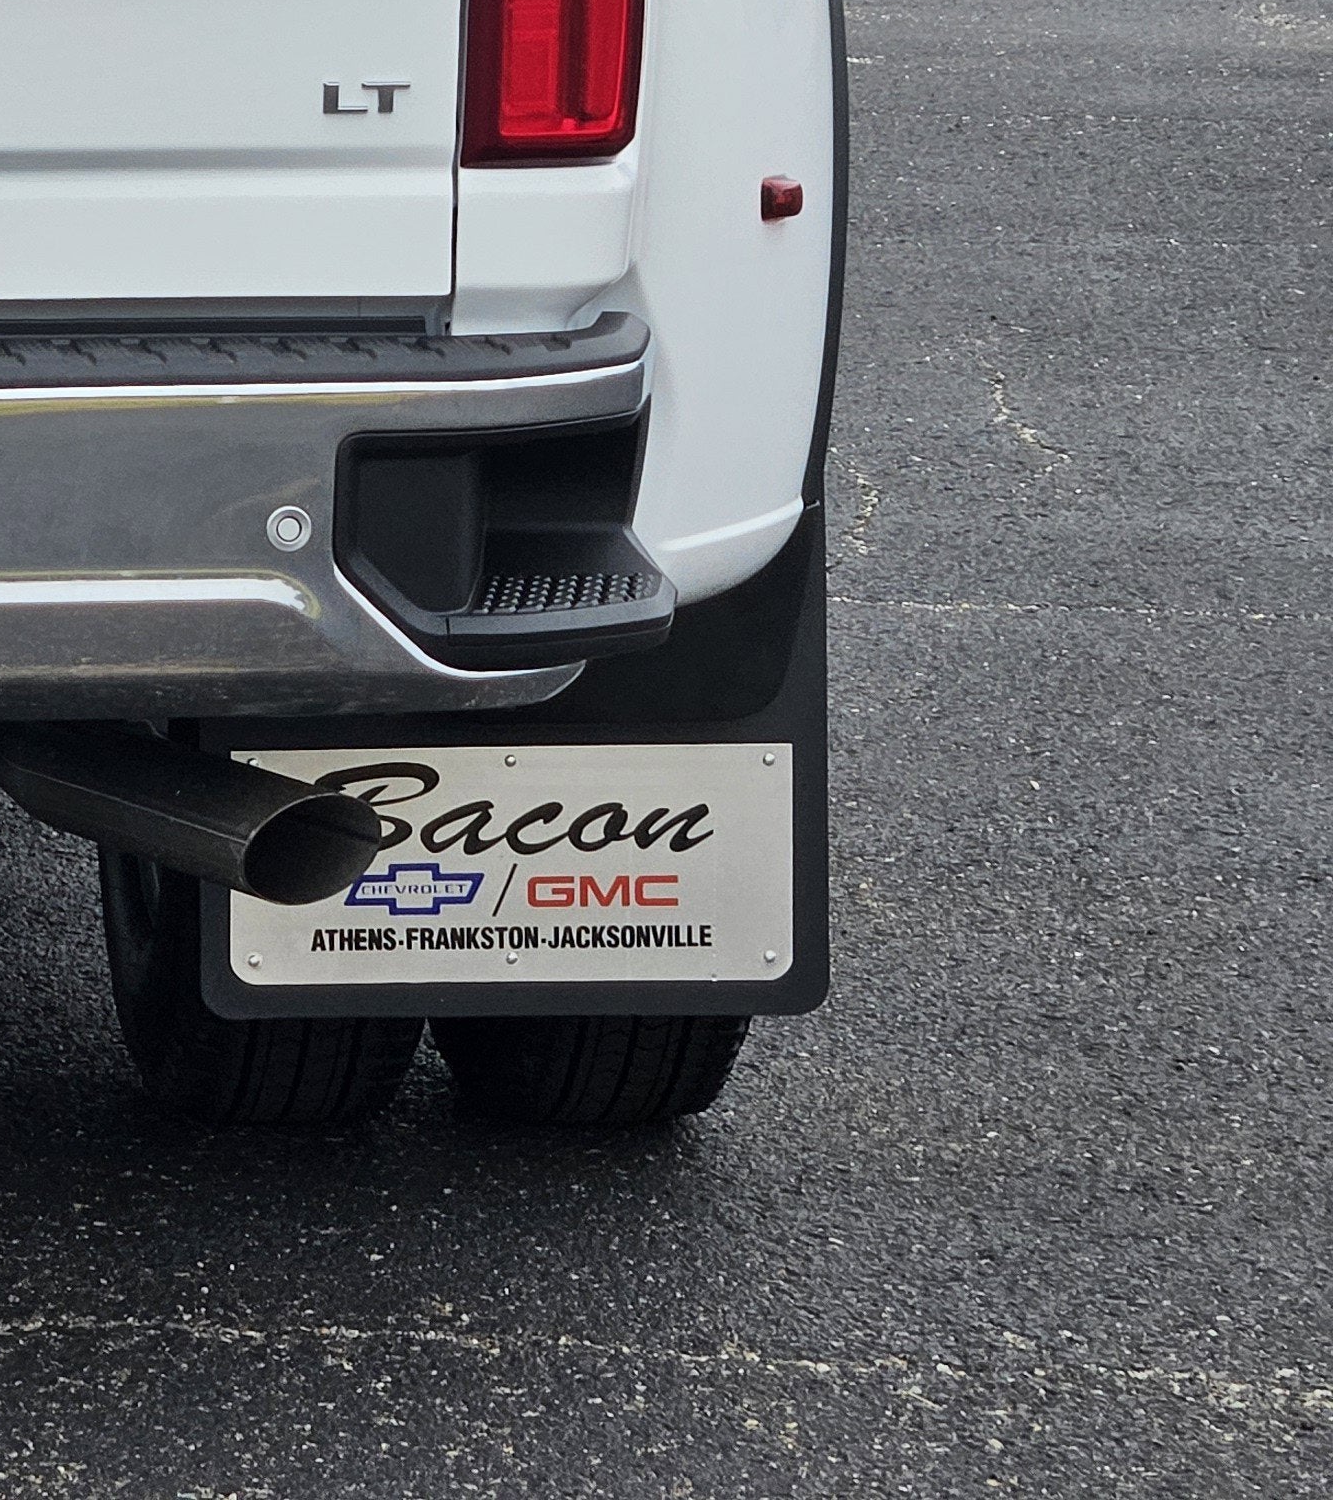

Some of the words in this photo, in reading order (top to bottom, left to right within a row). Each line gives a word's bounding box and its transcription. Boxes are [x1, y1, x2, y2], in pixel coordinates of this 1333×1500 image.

[322, 81, 411, 114] LT
[314, 762, 715, 855] Bacon
[361, 883, 467, 895] CHEVROLET
[527, 875, 679, 907] GMC
